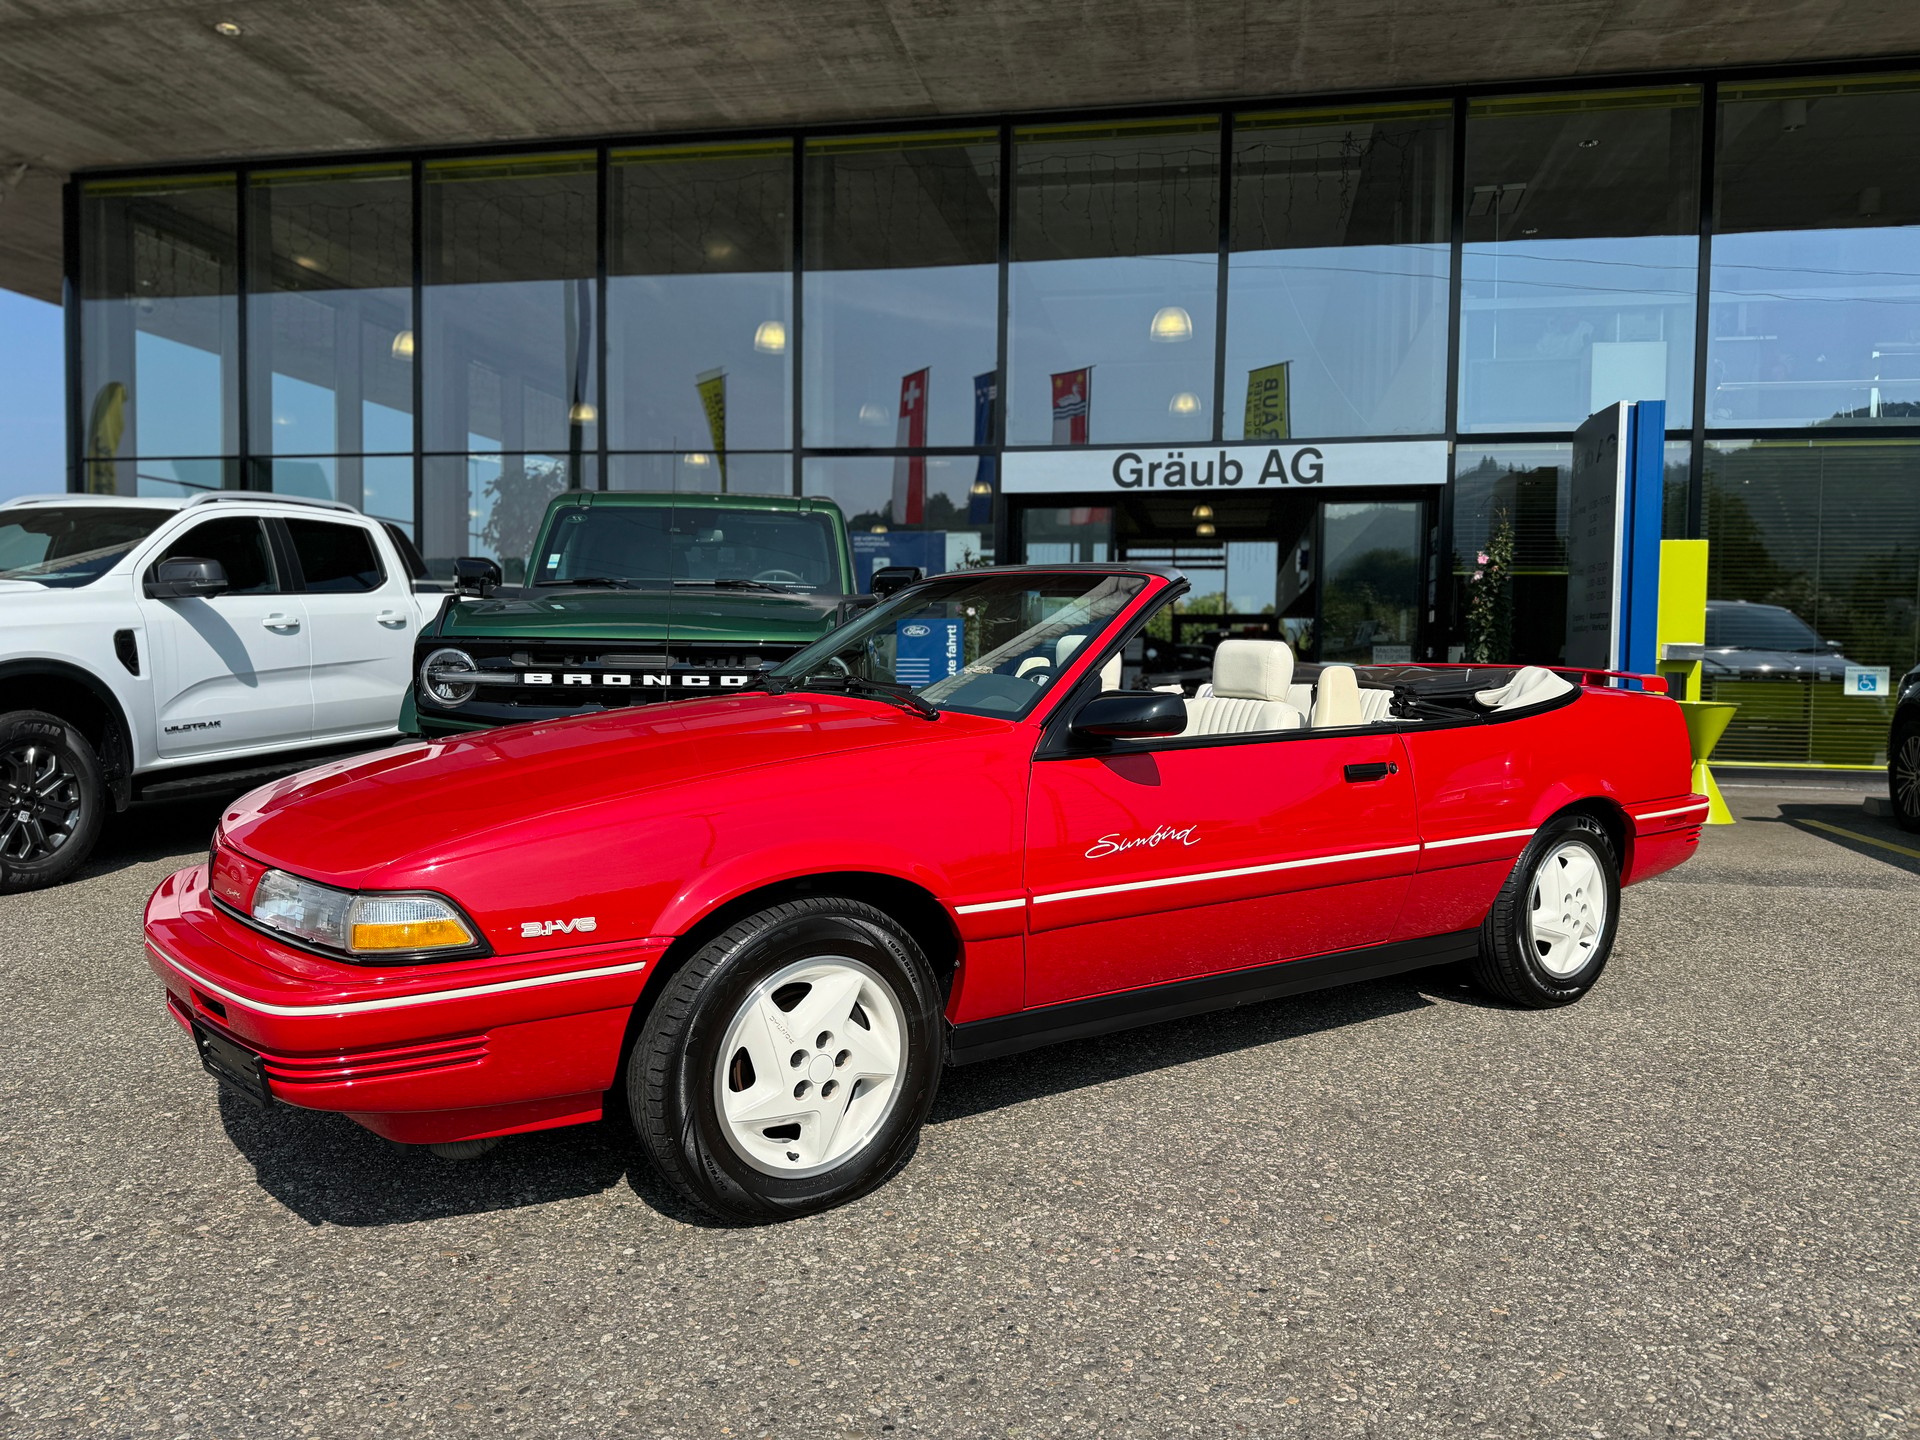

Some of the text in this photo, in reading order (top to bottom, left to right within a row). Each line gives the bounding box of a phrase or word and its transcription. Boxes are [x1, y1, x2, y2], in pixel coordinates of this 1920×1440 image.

[1112, 447, 1324, 488] Gräub AG
[906, 626, 927, 636] Ford
[946, 625, 957, 657] fahrt!
[524, 673, 748, 687] BRONCO
[164, 720, 221, 733] WILDTRAK
[1084, 824, 1202, 859] Sunbird
